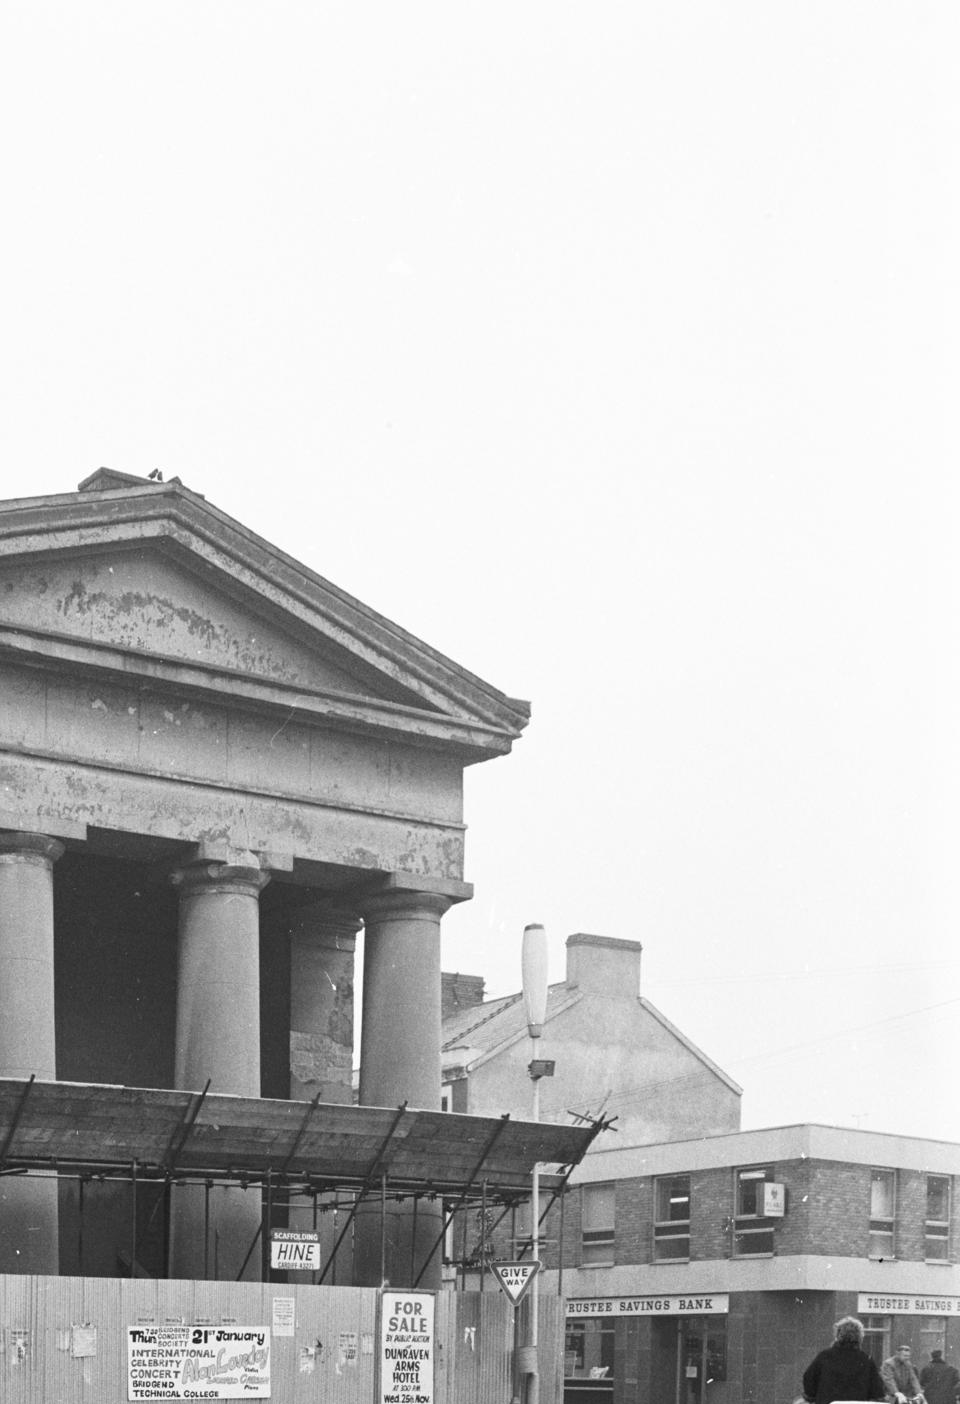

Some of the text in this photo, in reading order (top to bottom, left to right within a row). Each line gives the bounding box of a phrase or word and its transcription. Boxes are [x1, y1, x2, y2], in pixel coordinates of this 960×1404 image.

[274, 1232, 318, 1241] SCAFFOLDING
[277, 1243, 315, 1261] HINE
[501, 1268, 529, 1278] GIVE
[395, 1301, 422, 1316] FOR
[619, 1300, 671, 1311] SAVINGS
[678, 1298, 713, 1310] BANK
[867, 1298, 910, 1310] TRUSTEE
[915, 1300, 953, 1311] SAVINGS
[388, 1316, 428, 1333] SALE
[216, 1330, 265, 1346] January
[132, 1349, 216, 1359] INTERNATIONAL
[385, 1348, 430, 1360] DUNRAVEN
[132, 1359, 182, 1368] CELEBRITY
[394, 1361, 421, 1372] ARMS
[131, 1369, 181, 1379] CONCERT
[182, 1358, 216, 1385] Alan
[133, 1380, 175, 1388] BRIDGEND
[392, 1372, 420, 1384] HOTEL
[133, 1389, 220, 1398] TECHNICAL COLLEGE
